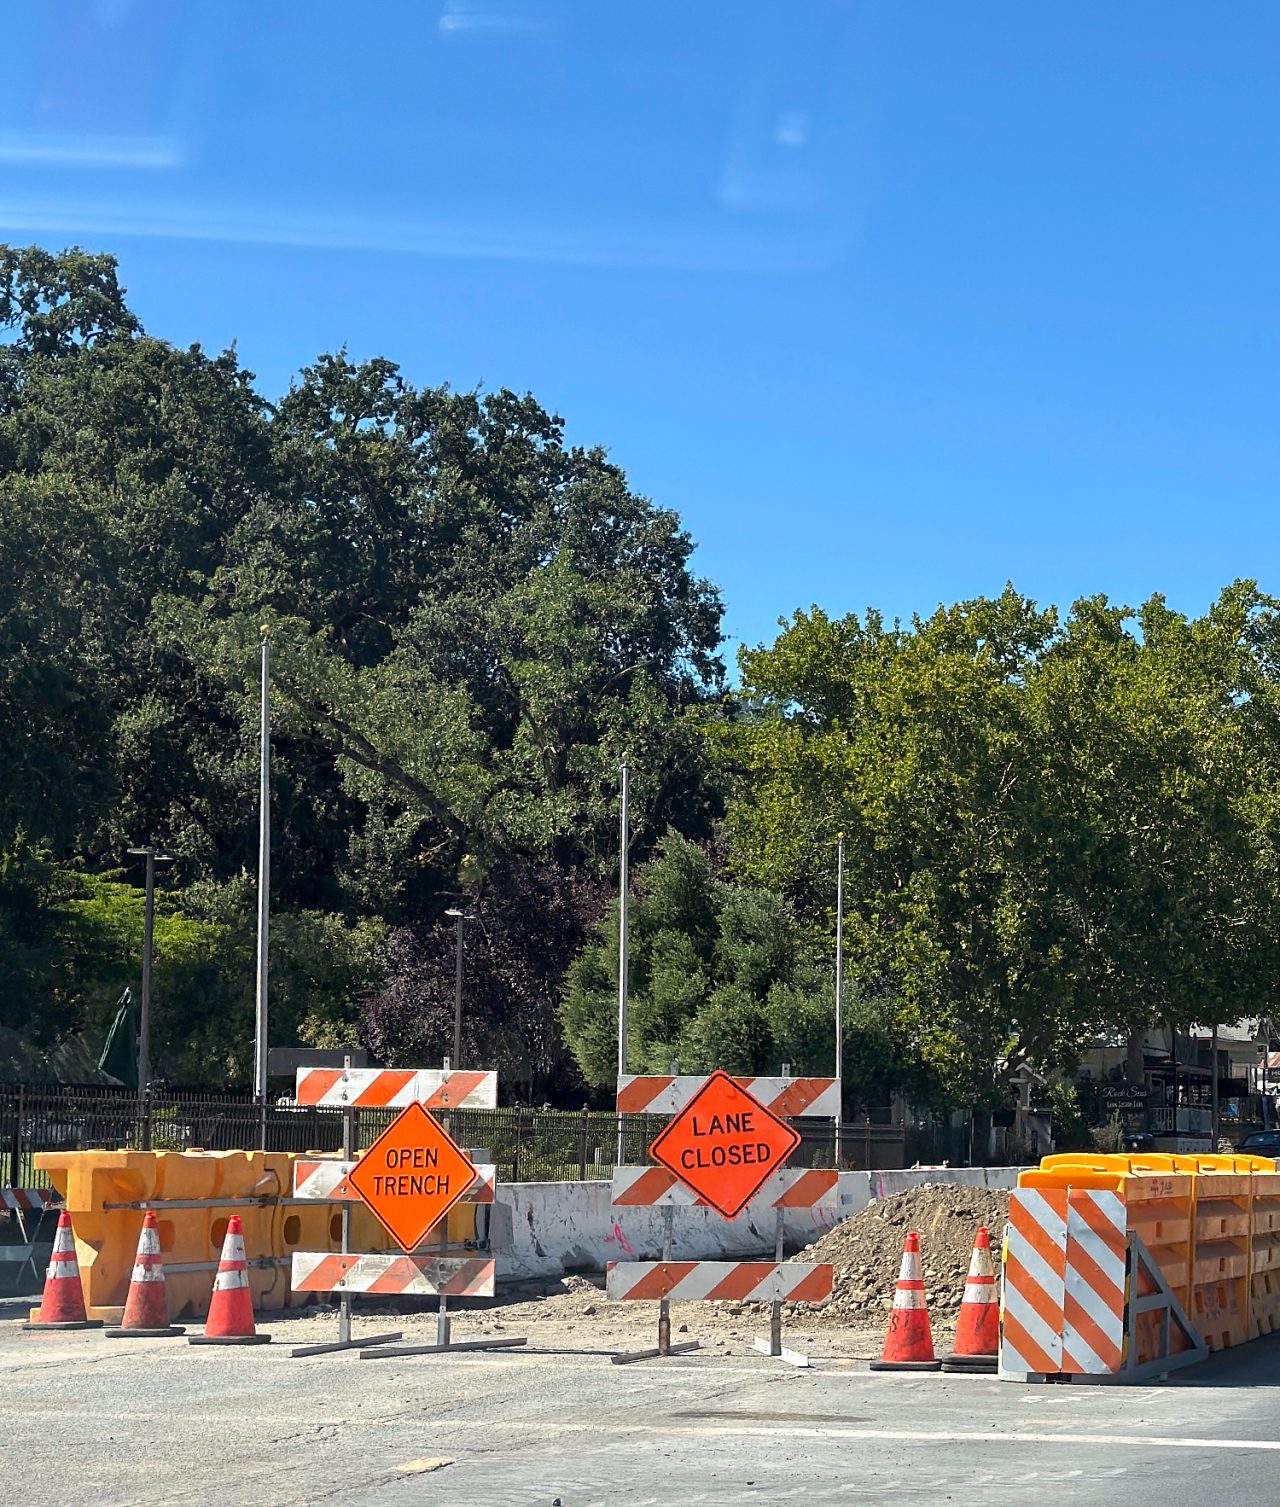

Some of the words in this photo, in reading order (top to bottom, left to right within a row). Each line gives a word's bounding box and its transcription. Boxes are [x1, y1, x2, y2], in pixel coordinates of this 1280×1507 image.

[693, 1112, 755, 1137] LANE
[386, 1147, 438, 1169] OPEN
[681, 1143, 771, 1170] CLOSED
[373, 1174, 450, 1196] TRENCH
